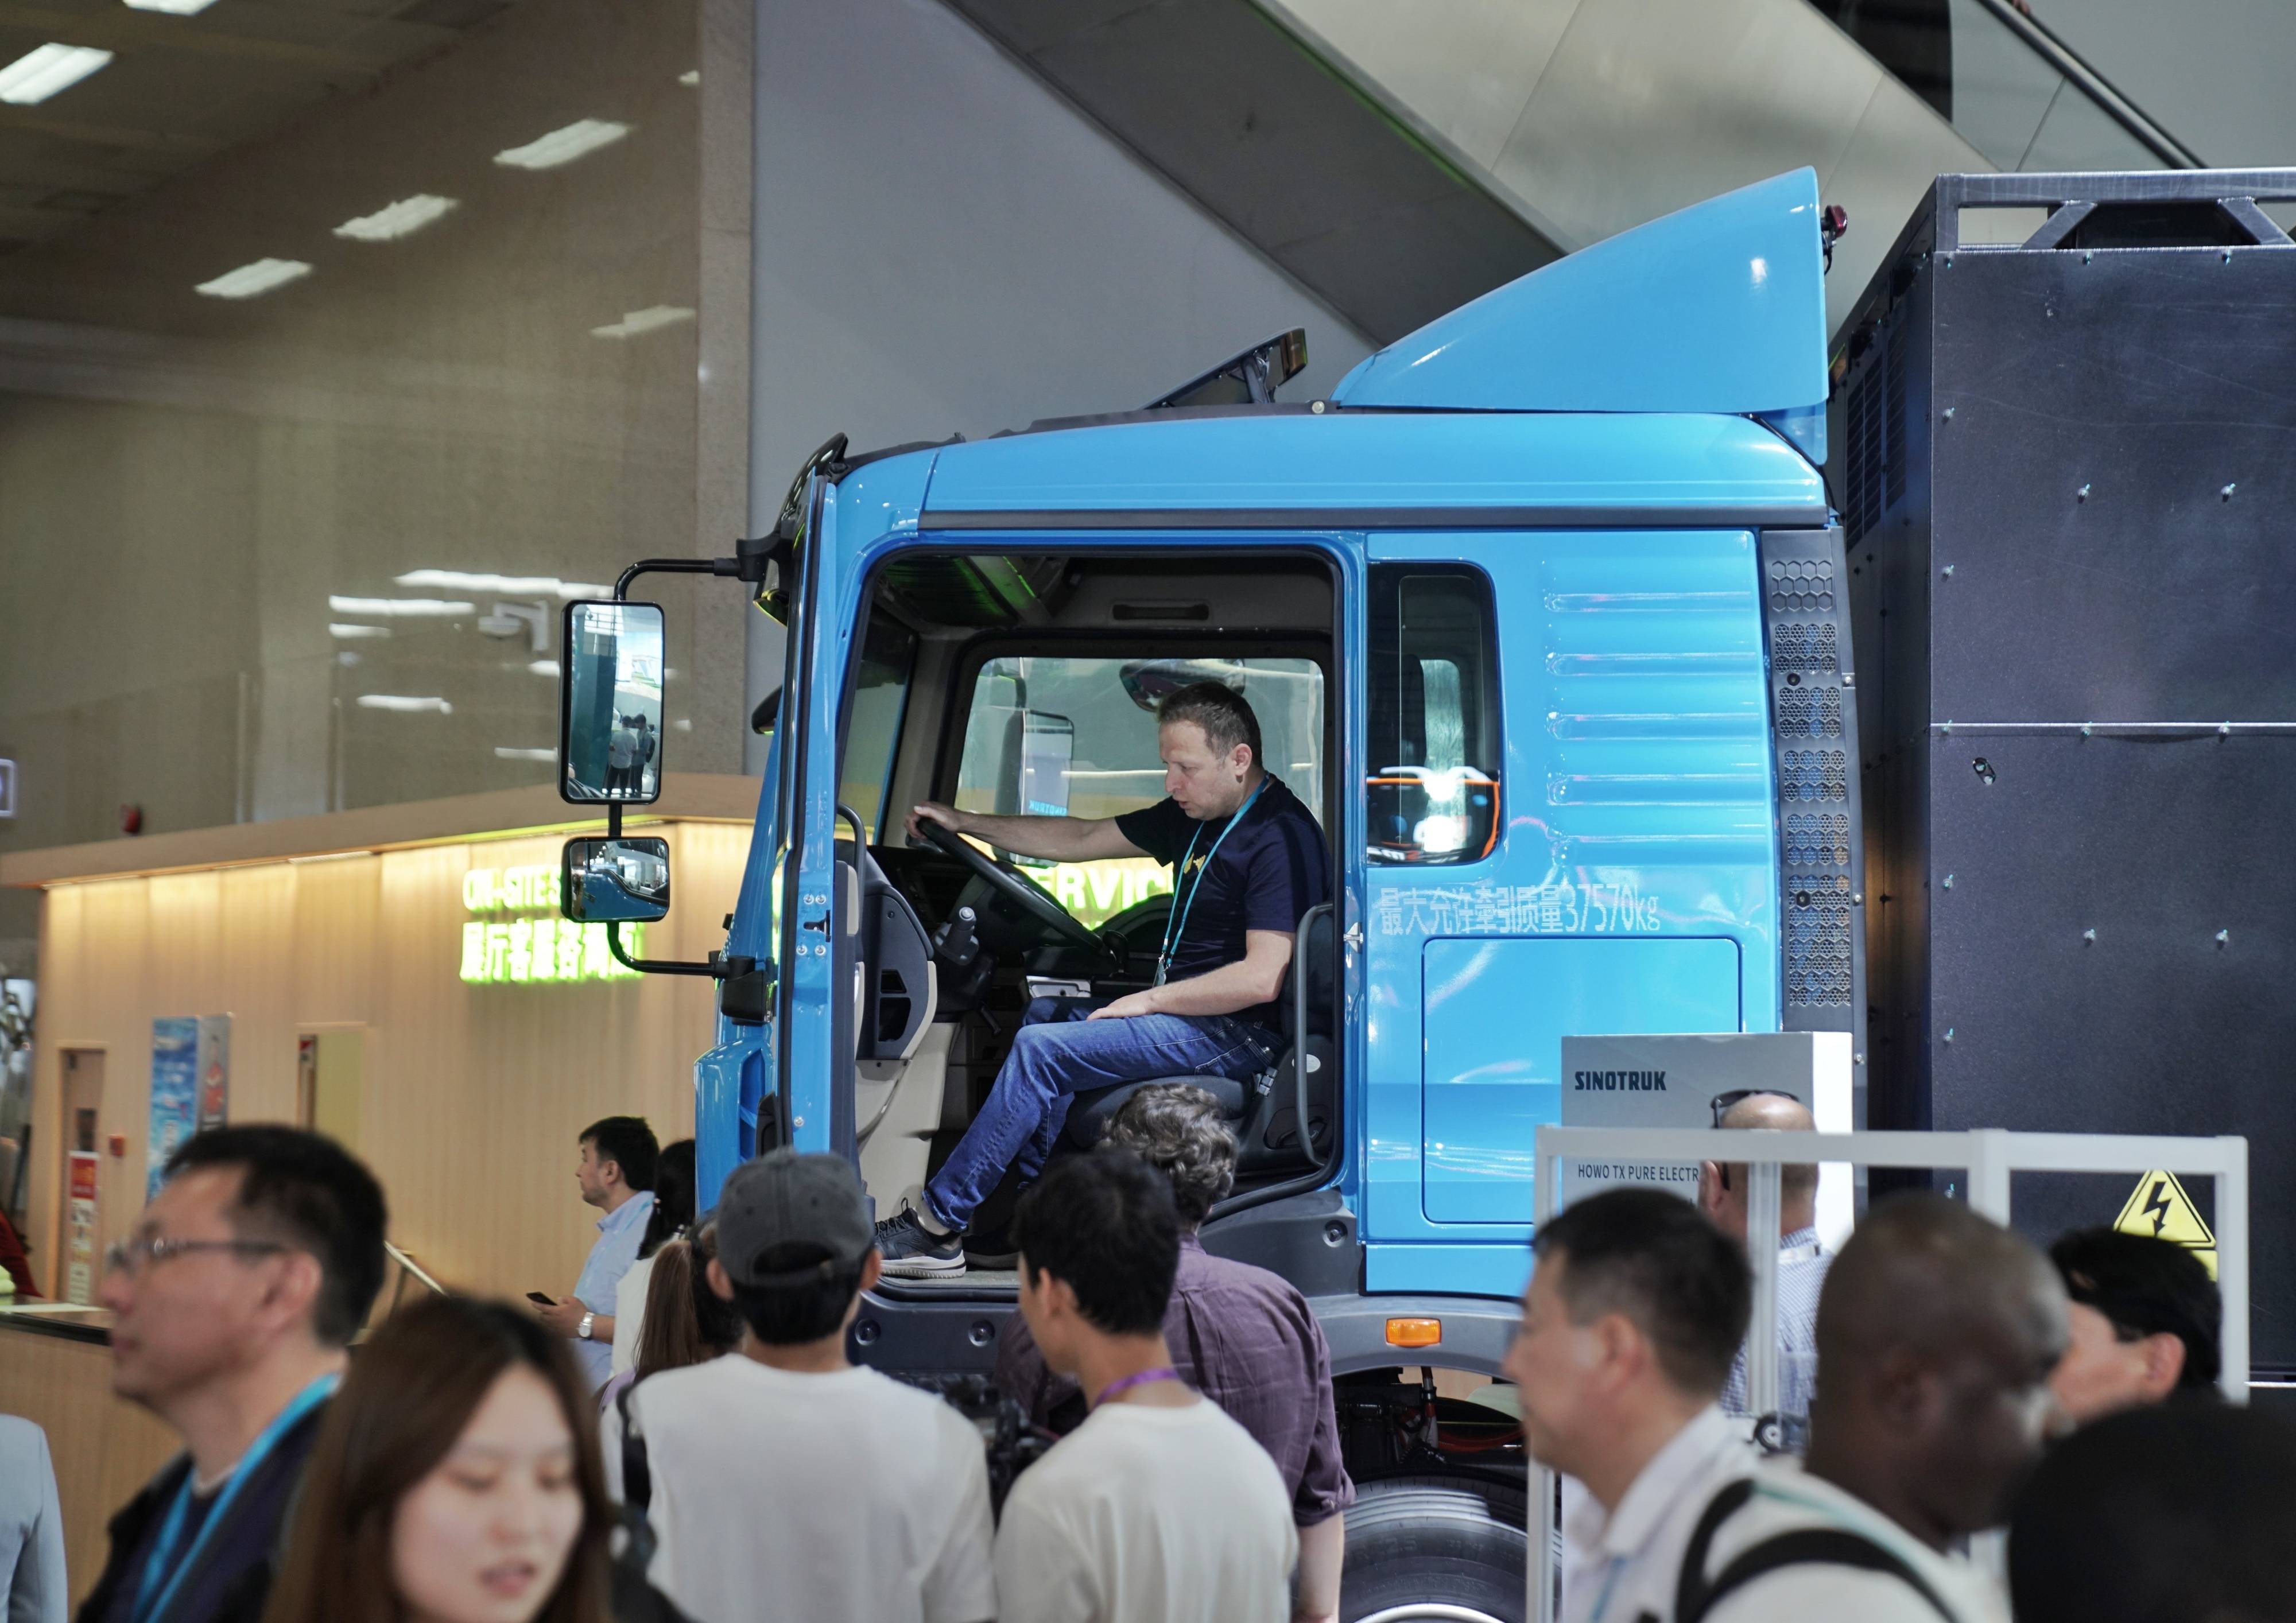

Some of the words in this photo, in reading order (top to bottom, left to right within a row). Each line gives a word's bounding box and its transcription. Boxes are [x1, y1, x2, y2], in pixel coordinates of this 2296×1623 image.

[1574, 1071, 1666, 1091] SINOTRUK
[1578, 1164, 1609, 1179] HOWO
[1612, 1165, 1626, 1179] TX
[1628, 1166, 1656, 1181] PURE
